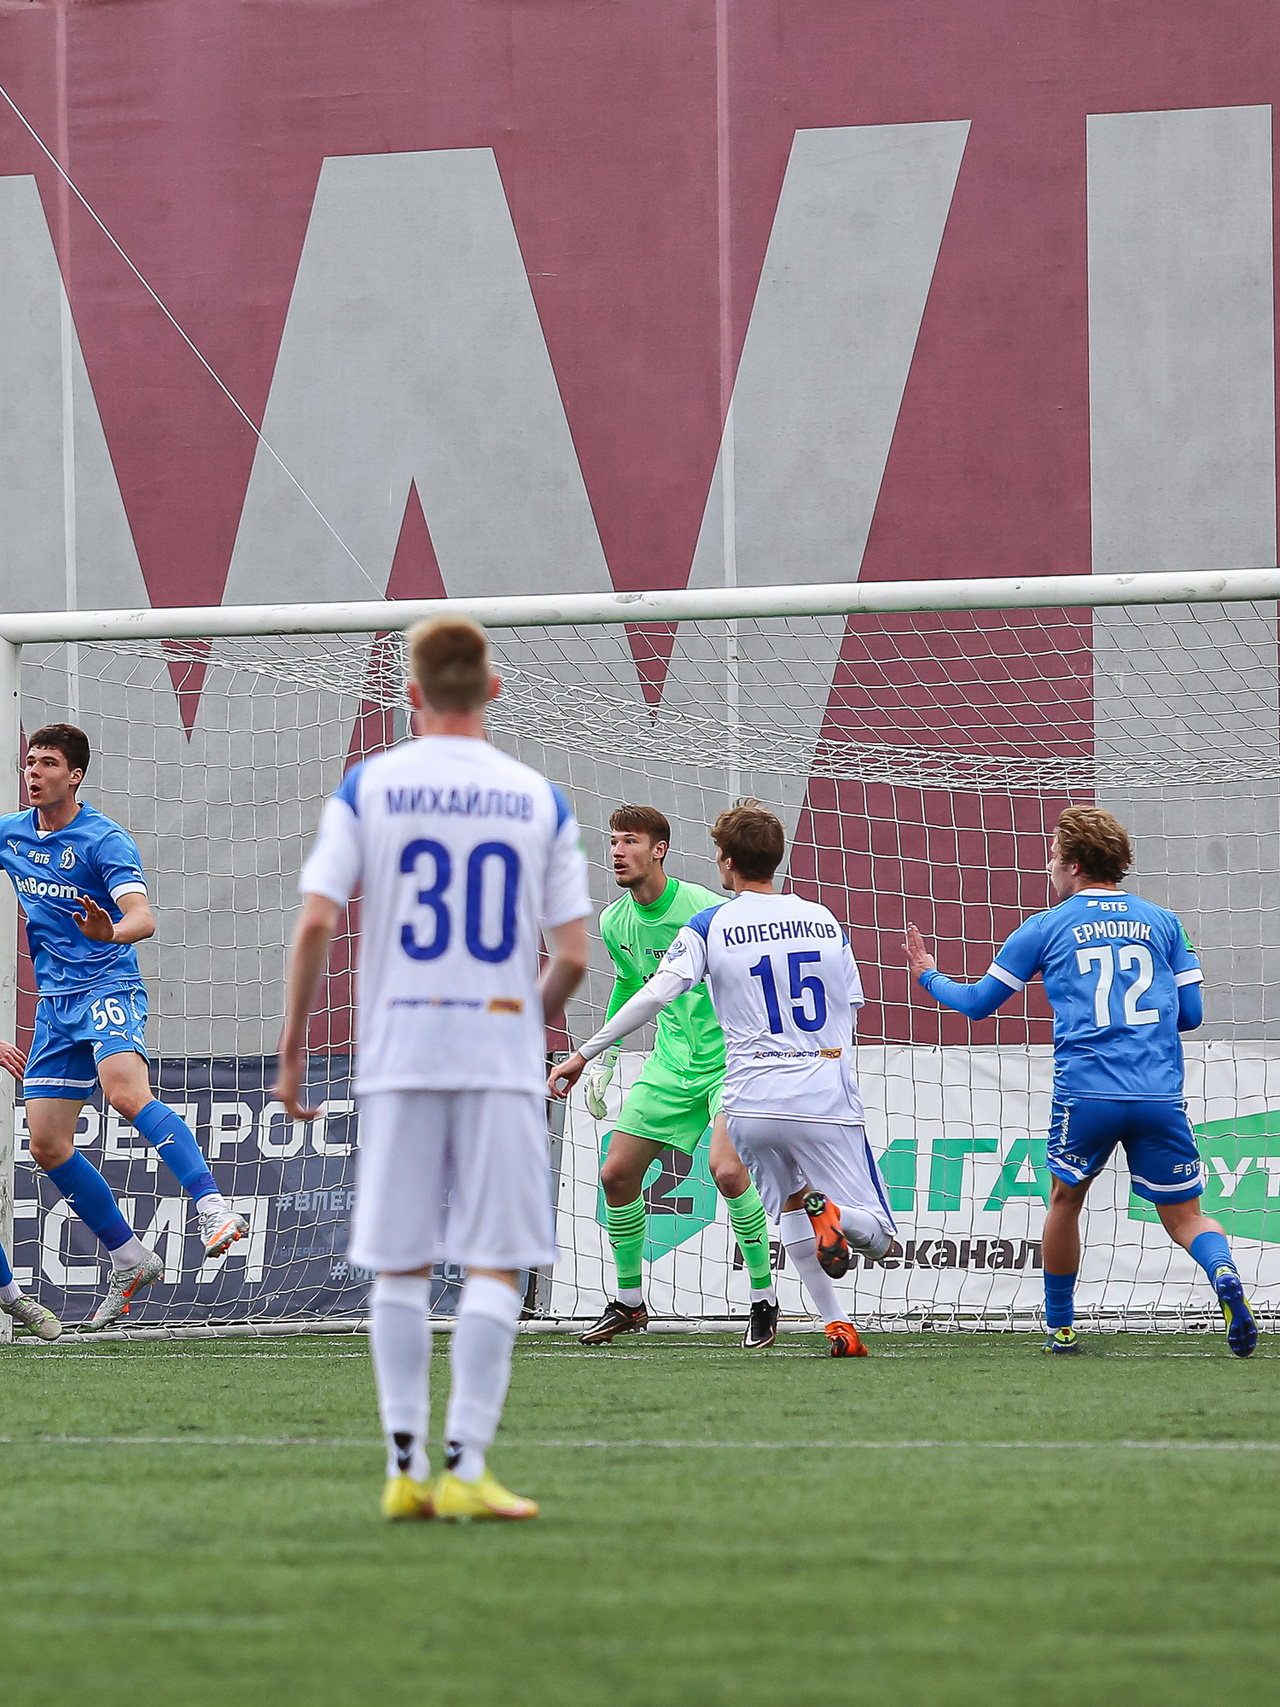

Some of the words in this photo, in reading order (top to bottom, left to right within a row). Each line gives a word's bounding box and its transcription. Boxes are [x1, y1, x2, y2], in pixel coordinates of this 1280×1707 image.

[384, 781, 535, 821] МИХАЙЛОВ
[398, 838, 519, 964] 30
[1099, 901, 1129, 913] ВТБ
[722, 919, 838, 947] КОЛЕСНИКОВ
[1072, 919, 1152, 945] ЕРМОЛИН
[749, 950, 828, 1035] 15
[1075, 944, 1161, 1028] 72
[90, 997, 127, 1031] 56
